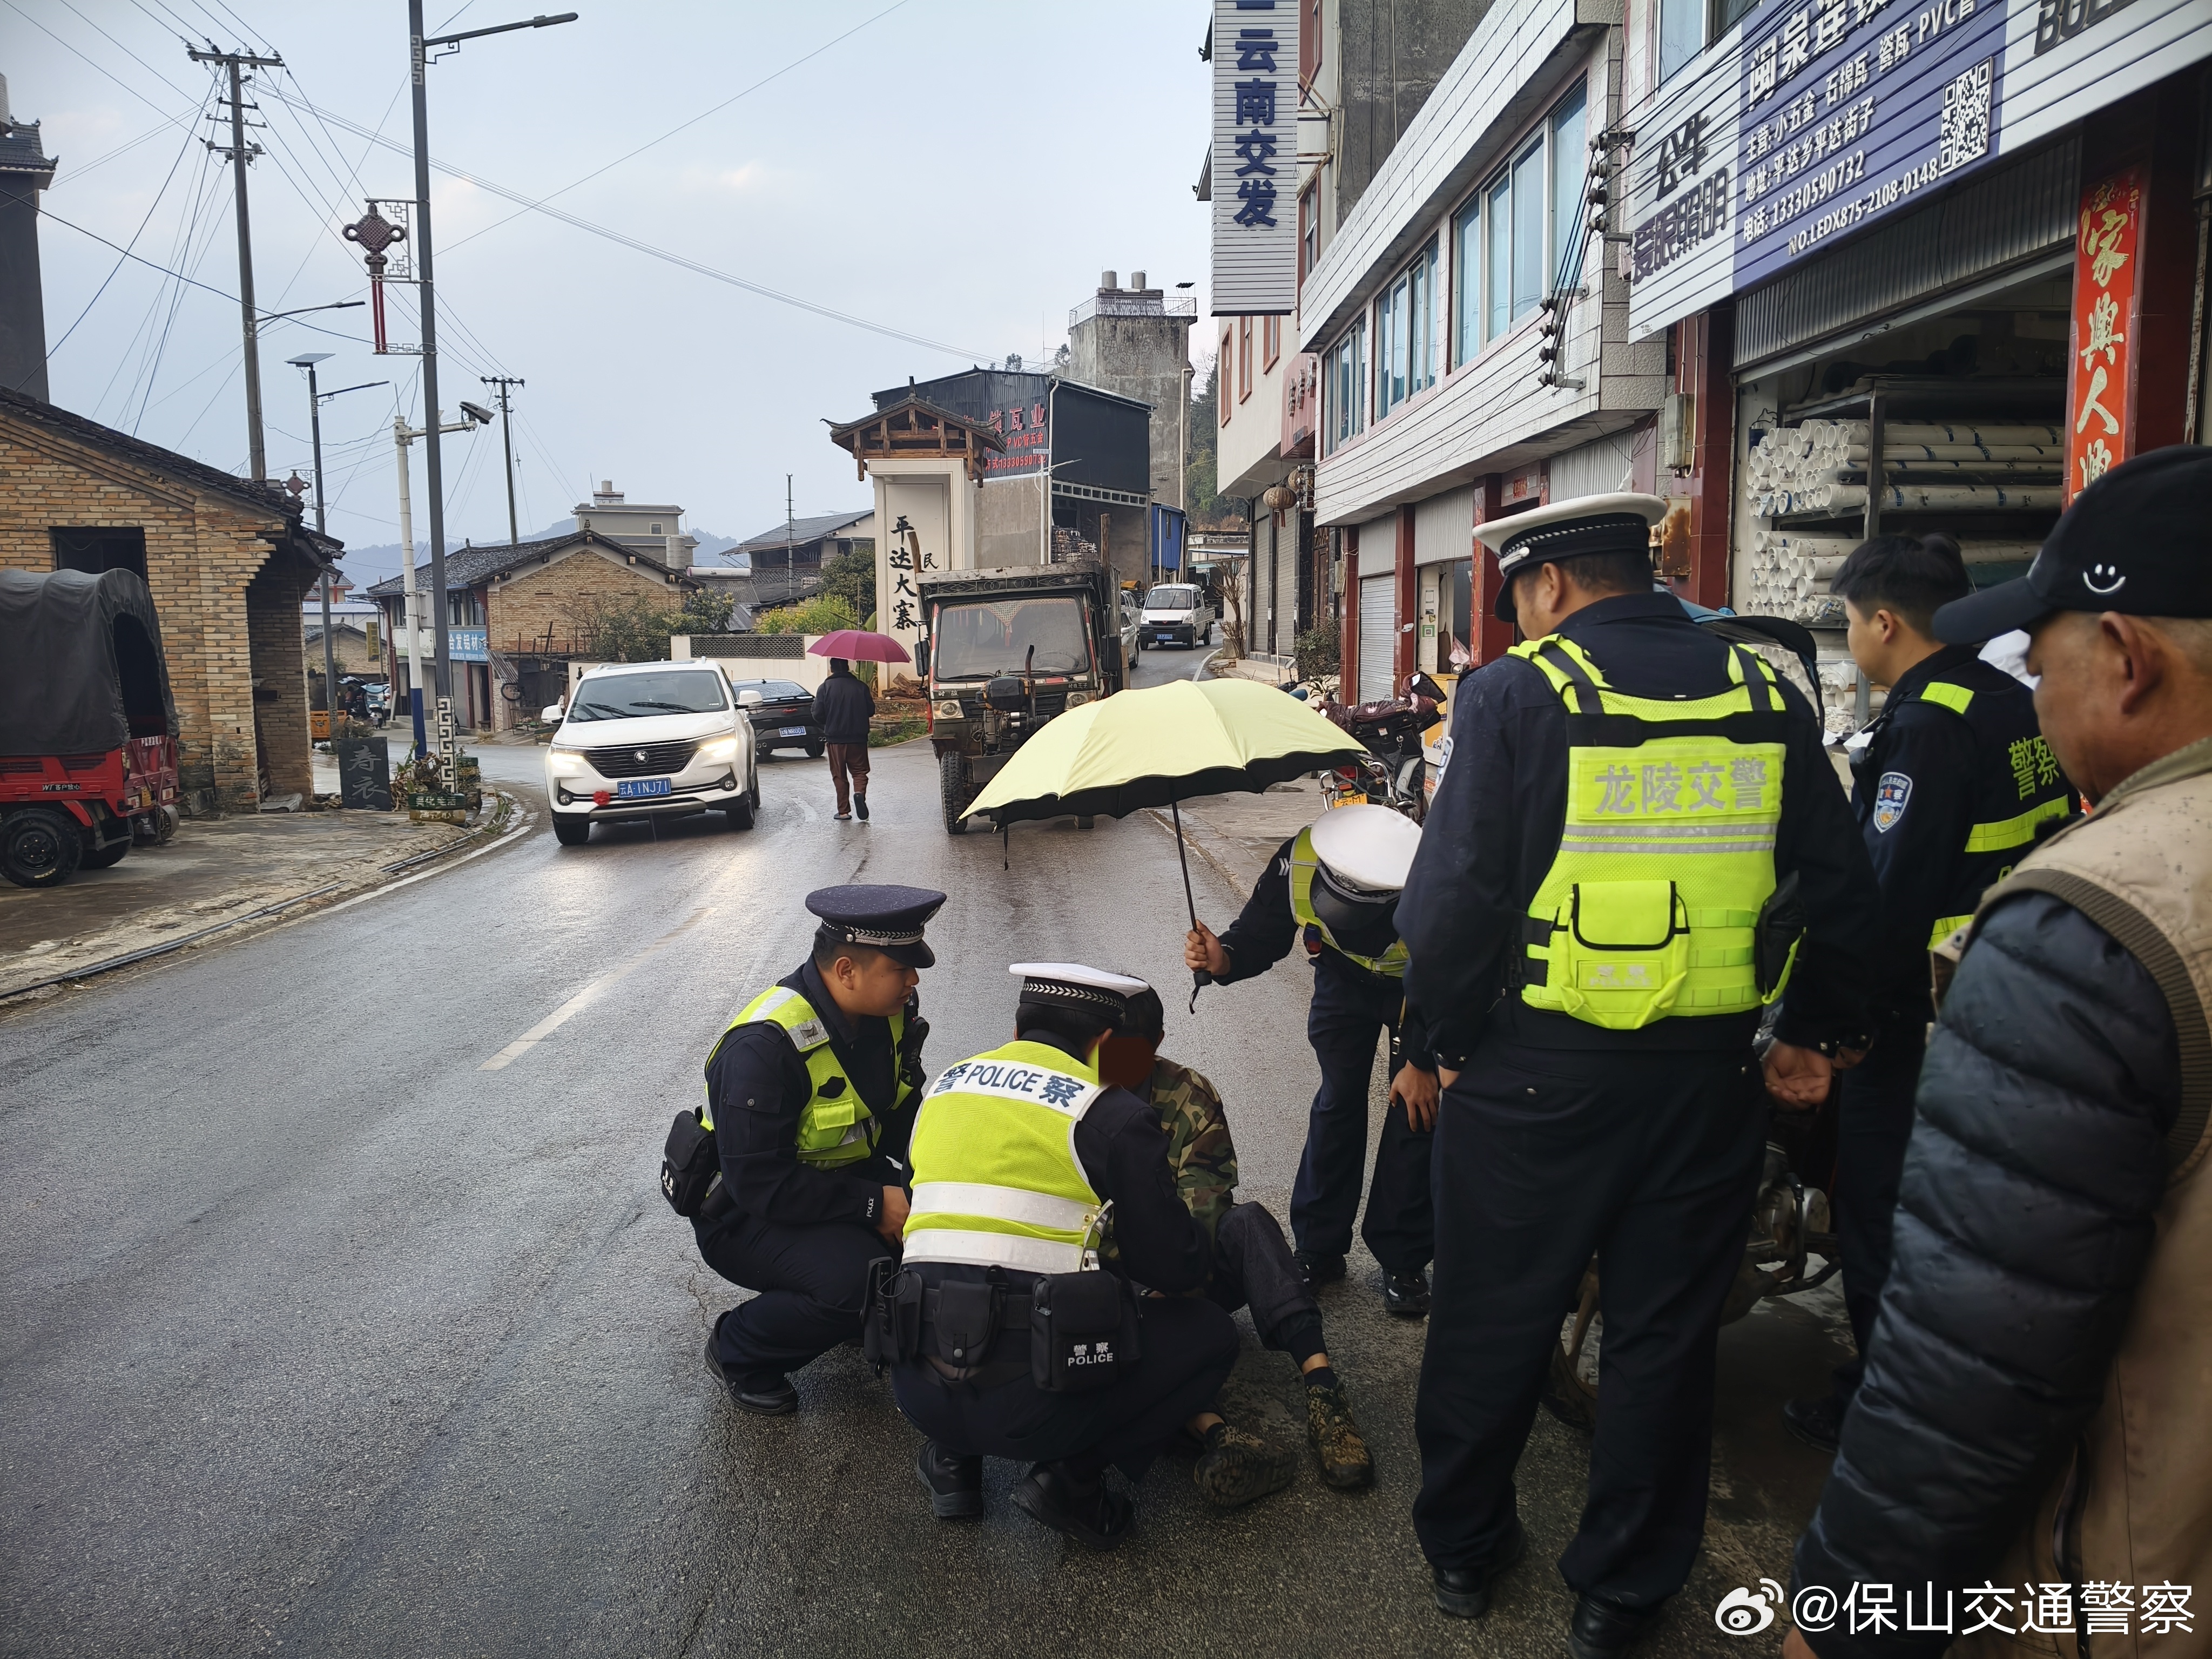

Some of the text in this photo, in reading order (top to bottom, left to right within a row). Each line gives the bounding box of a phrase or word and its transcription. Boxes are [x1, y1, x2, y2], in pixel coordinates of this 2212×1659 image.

[1826, 51, 1870, 106] 石棉瓦
[1879, 22, 1912, 72] 瓷瓦
[1233, 0, 1278, 227] 云南交发
[1633, 167, 1730, 286] 爱眼照明
[1789, 157, 1938, 256] NO.LEDX875-2108-0148
[890, 515, 918, 630] 平达大寨
[348, 745, 388, 810] 寿衣
[1594, 757, 1767, 814] 龙陵交警
[2008, 735, 2060, 801] 警察
[933, 1062, 1085, 1108] 警 POLICE 察
[1068, 1352, 1114, 1367] POLICE
